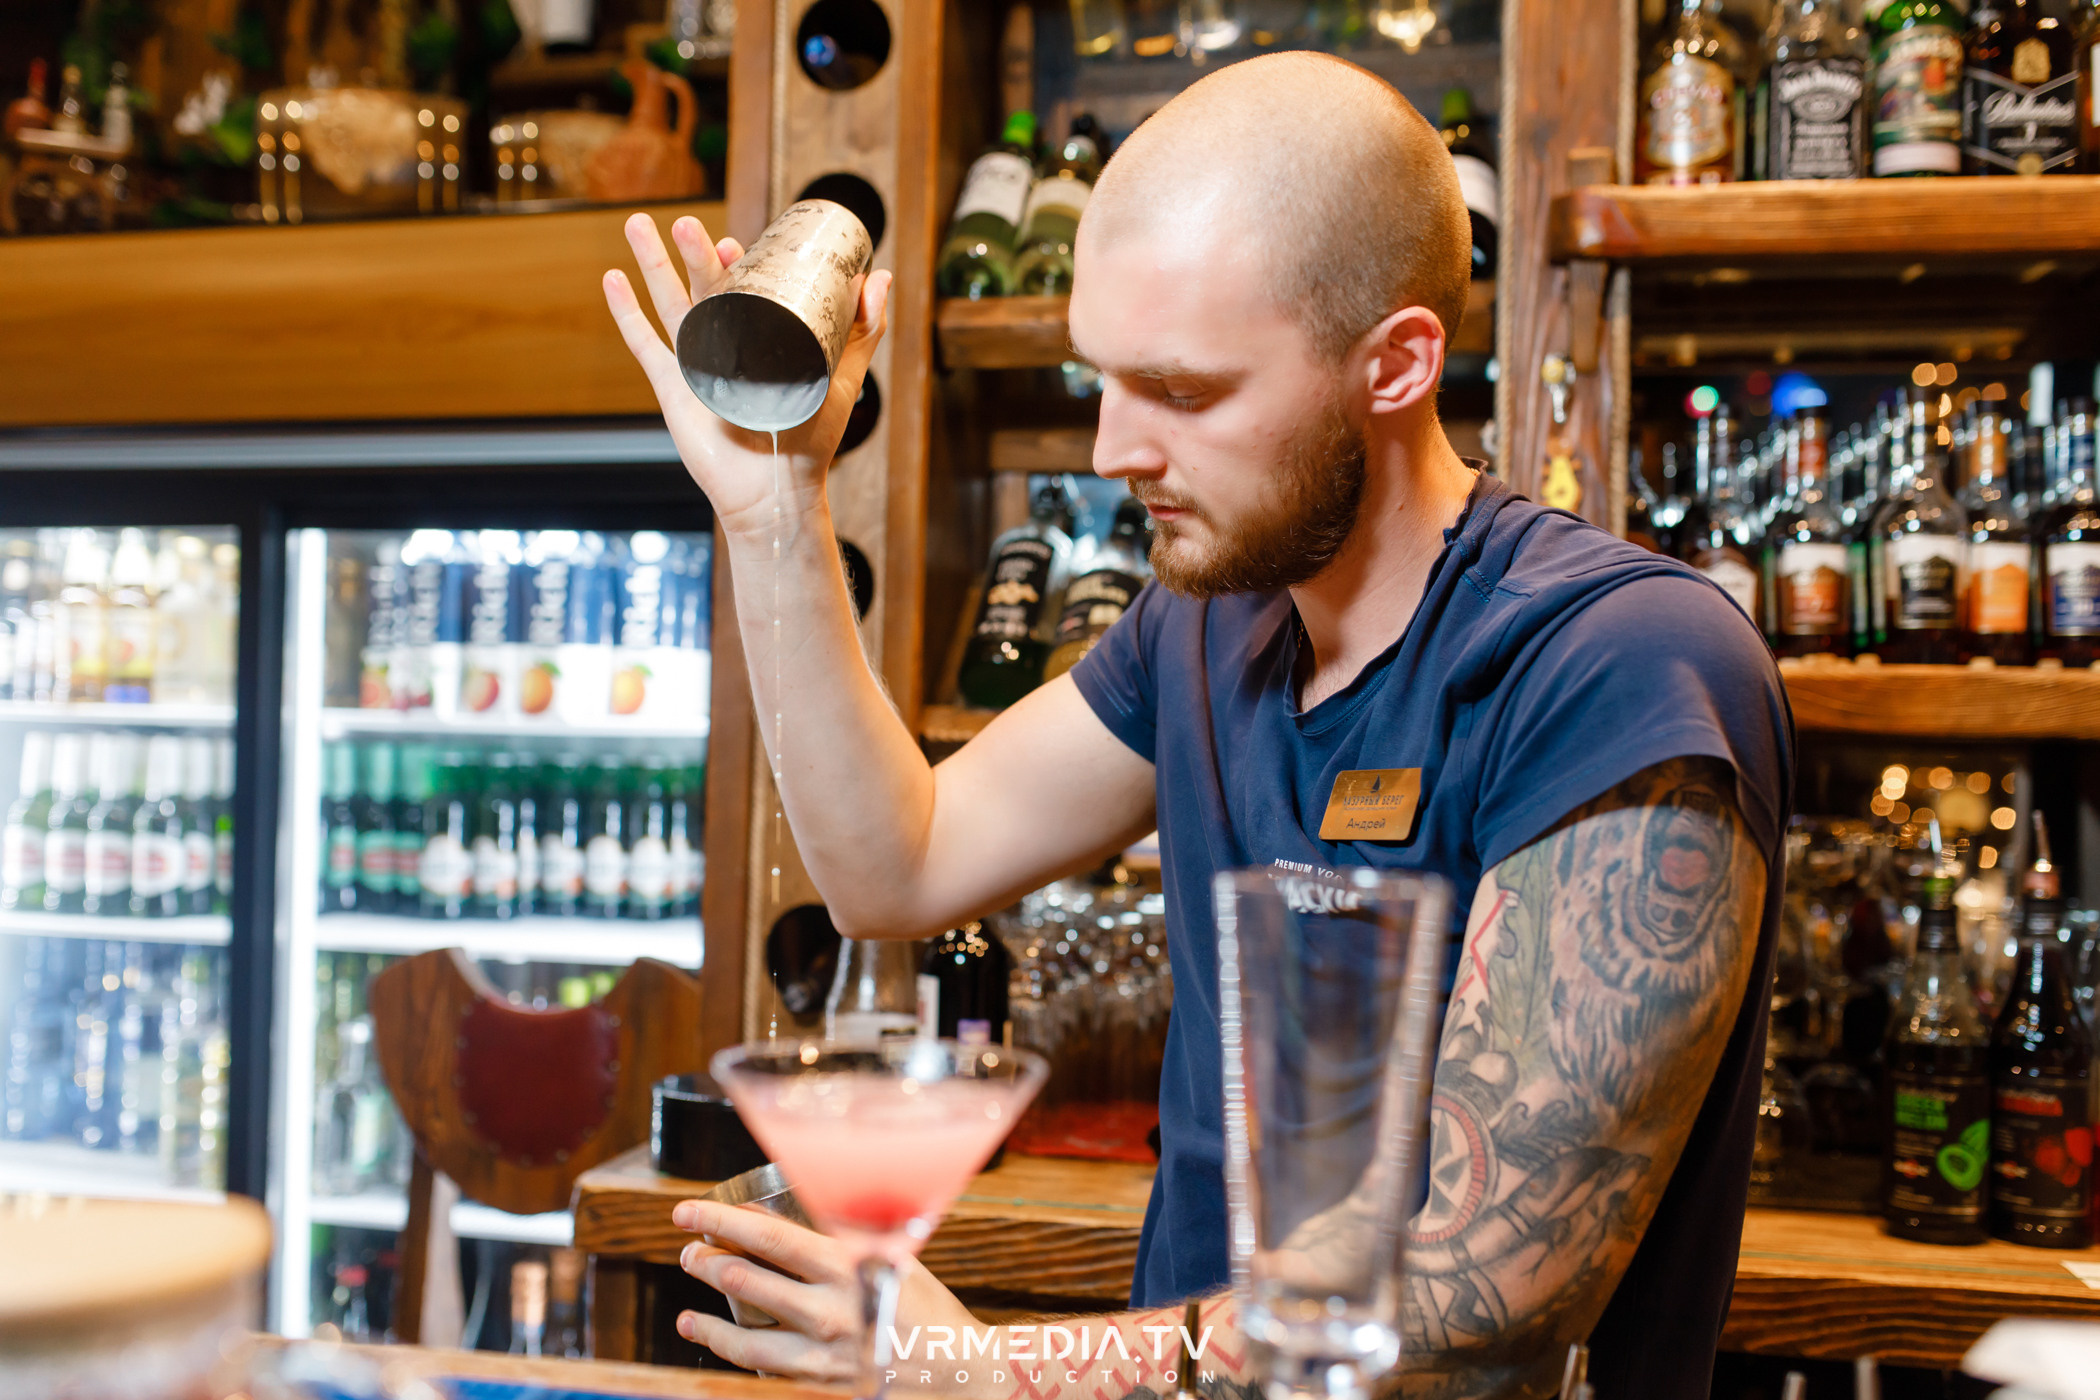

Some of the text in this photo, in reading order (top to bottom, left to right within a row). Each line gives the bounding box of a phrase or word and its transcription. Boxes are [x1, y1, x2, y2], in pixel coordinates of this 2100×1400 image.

[1381, 794, 1404, 806] БЕРЕГ
[1346, 818, 1386, 832] Андрей
[1274, 858, 1313, 874] PREMIUM
